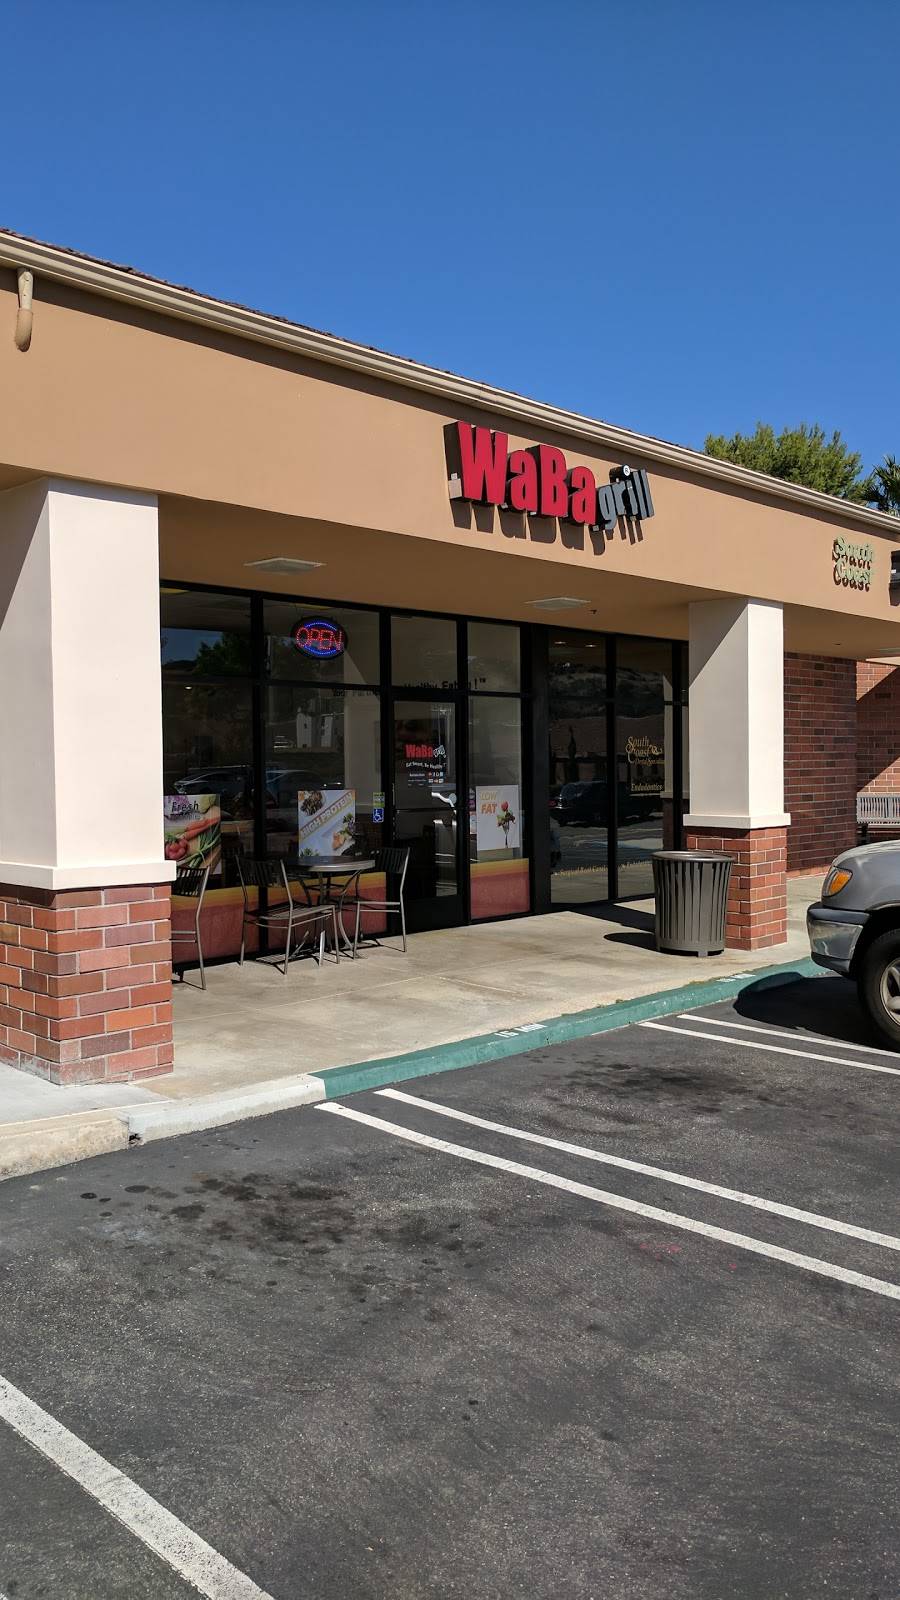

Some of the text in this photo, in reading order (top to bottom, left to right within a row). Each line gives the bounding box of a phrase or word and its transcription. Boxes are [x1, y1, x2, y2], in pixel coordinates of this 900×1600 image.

[457, 420, 655, 531] WaBa grill
[296, 627, 342, 651] OPEN
[480, 791, 497, 801] LOW
[172, 800, 199, 812] Fresh
[480, 803, 497, 814] FAT
